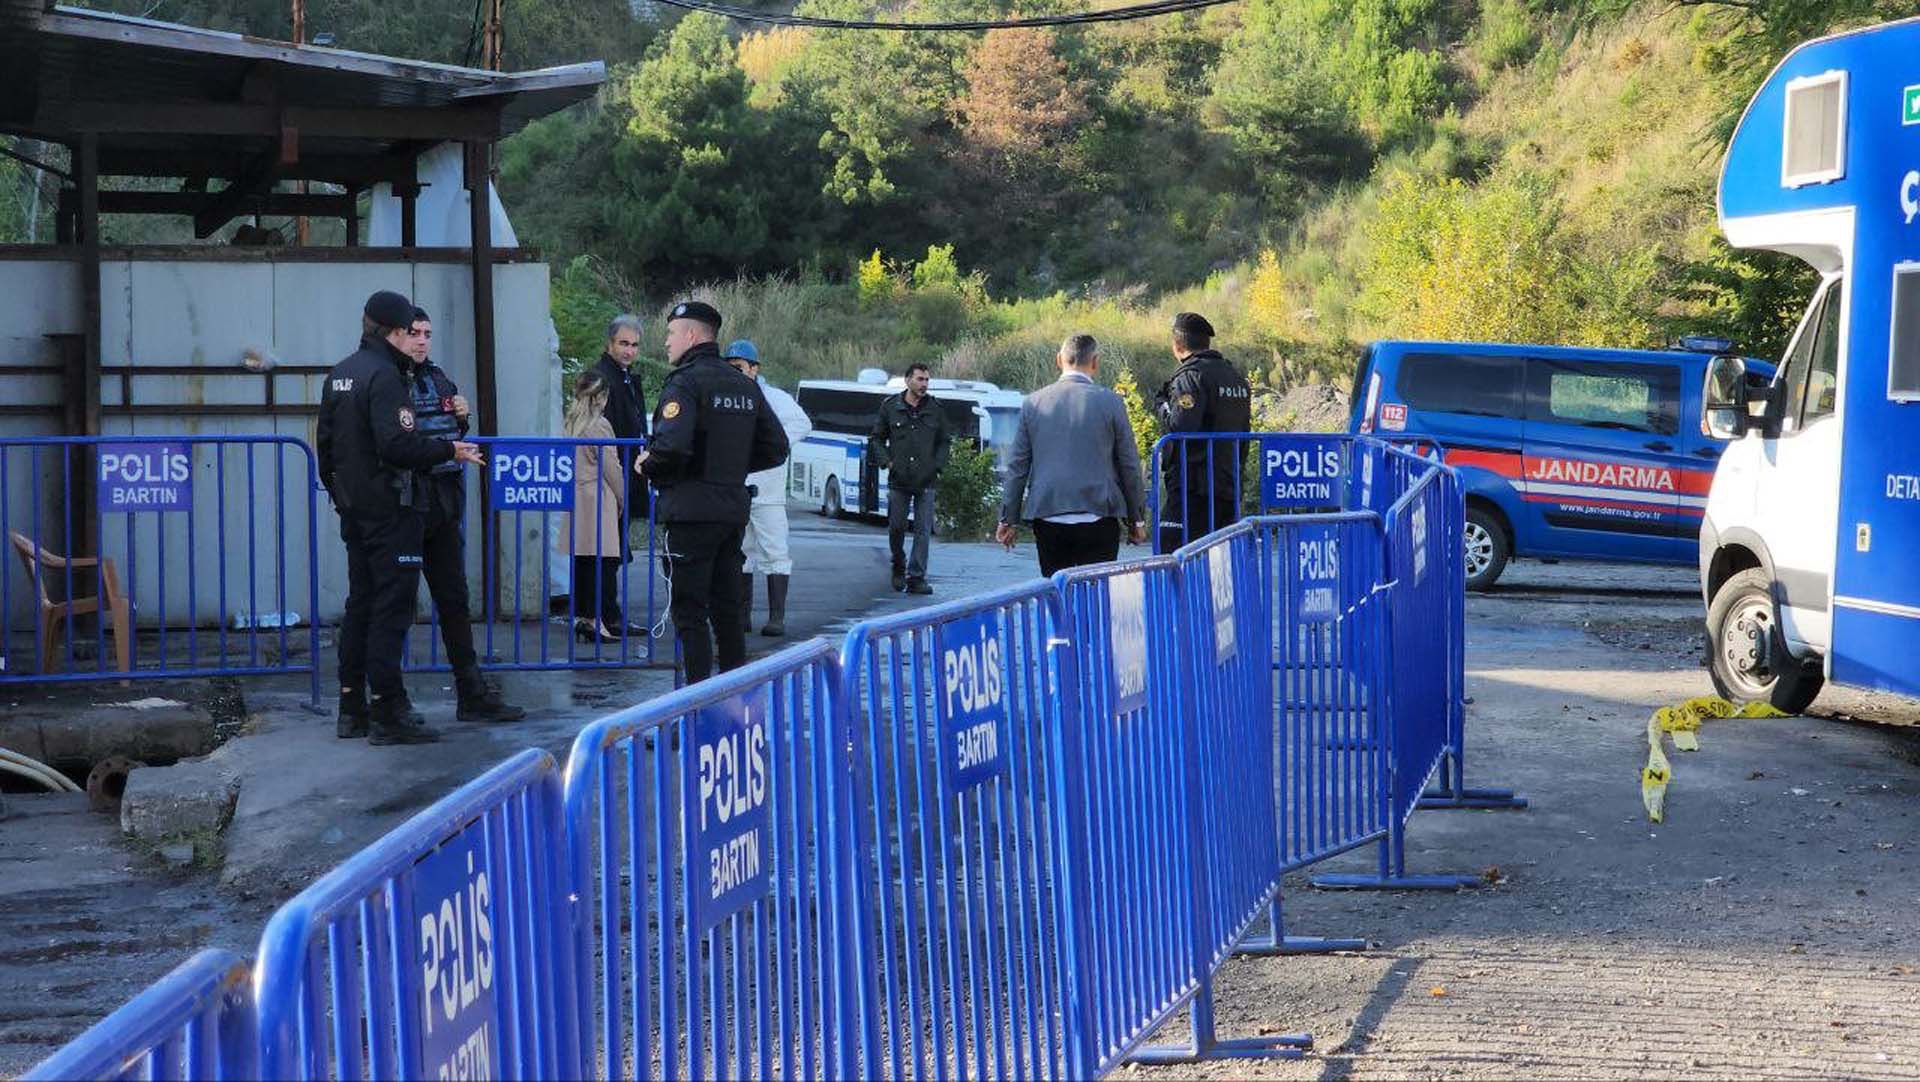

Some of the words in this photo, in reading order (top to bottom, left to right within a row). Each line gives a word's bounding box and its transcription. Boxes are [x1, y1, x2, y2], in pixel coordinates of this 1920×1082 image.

[1384, 406, 1404, 419] 112
[101, 448, 189, 482] POLİS
[495, 449, 573, 482] POLİS
[1266, 445, 1340, 478] POLİS
[1532, 459, 1674, 490] JANDARMA
[113, 487, 177, 504] BARTIN
[505, 487, 562, 504] BARTIN
[1276, 483, 1330, 499] BARTIN
[1560, 503, 1661, 520] www.jandarma.gov.tr
[1300, 530, 1336, 581] POLİS
[944, 624, 1000, 718] POLİS
[957, 720, 998, 770] BARTIN
[700, 706, 764, 831] POLİS
[711, 829, 759, 899] BARTIN
[421, 851, 492, 1035] POLİS
[440, 1021, 490, 1082] RTIN
